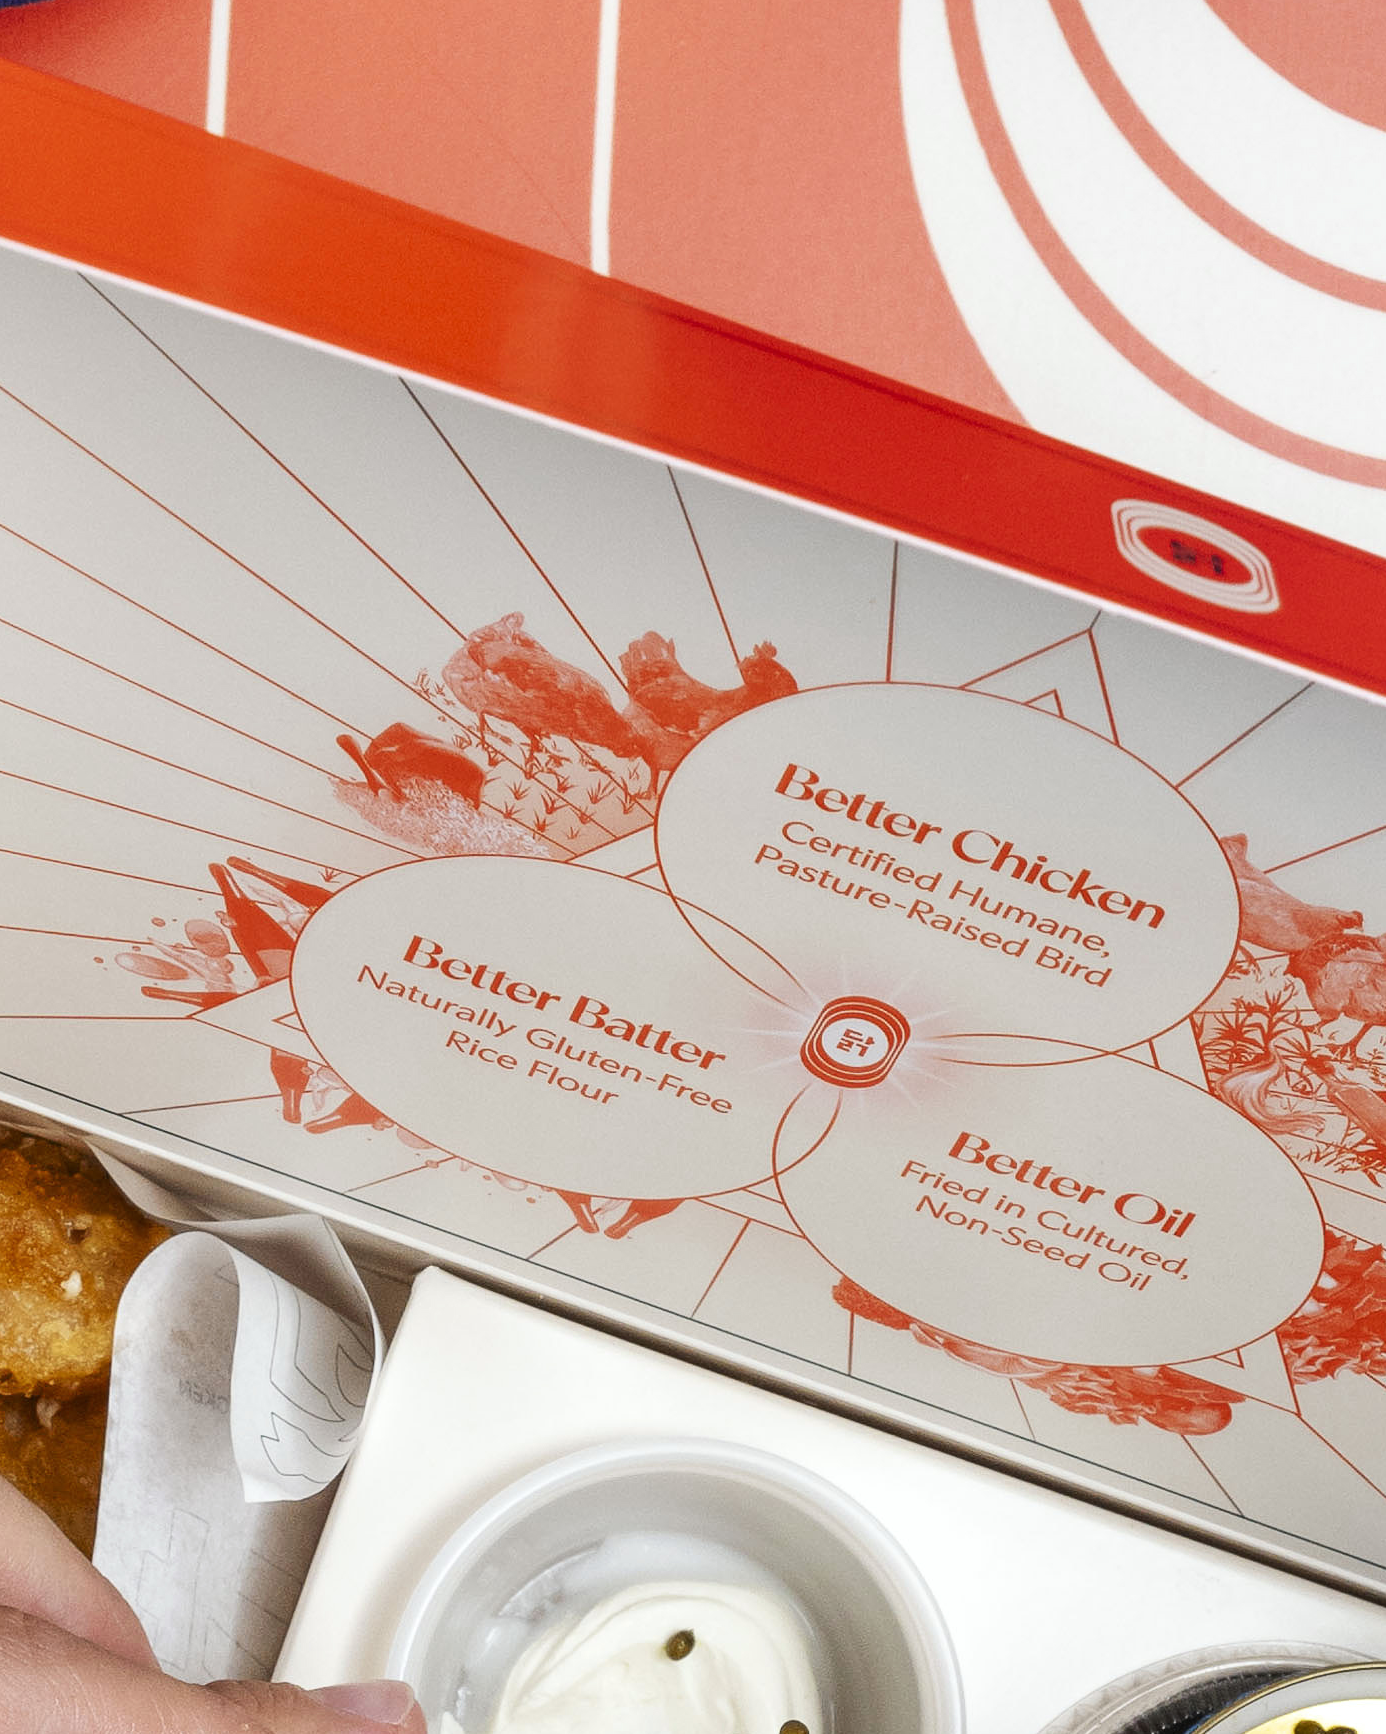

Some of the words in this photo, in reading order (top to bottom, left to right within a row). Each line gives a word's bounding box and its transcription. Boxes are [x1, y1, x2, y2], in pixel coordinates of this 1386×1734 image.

[775, 763, 941, 846] Better
[951, 829, 1166, 929] Chicken
[781, 821, 943, 893] Certified
[949, 880, 1111, 958] Humane,
[753, 843, 1028, 958] Pasture-Raised
[1035, 945, 1114, 988] Bird
[357, 965, 517, 1038] Naturally
[525, 1027, 734, 1114] Gluten-Free
[402, 935, 561, 1011] Better
[568, 995, 727, 1070] Batter
[445, 1030, 518, 1070] Rice
[527, 1059, 619, 1106] Flour
[900, 1160, 989, 1206] Fried
[995, 1193, 1026, 1219] in
[1037, 1205, 1190, 1281] Cultured,
[915, 1195, 1090, 1271] Non-Seed
[1098, 1260, 1153, 1292] Oil
[948, 1131, 1106, 1204] Better
[1114, 1191, 1197, 1238] Oil
